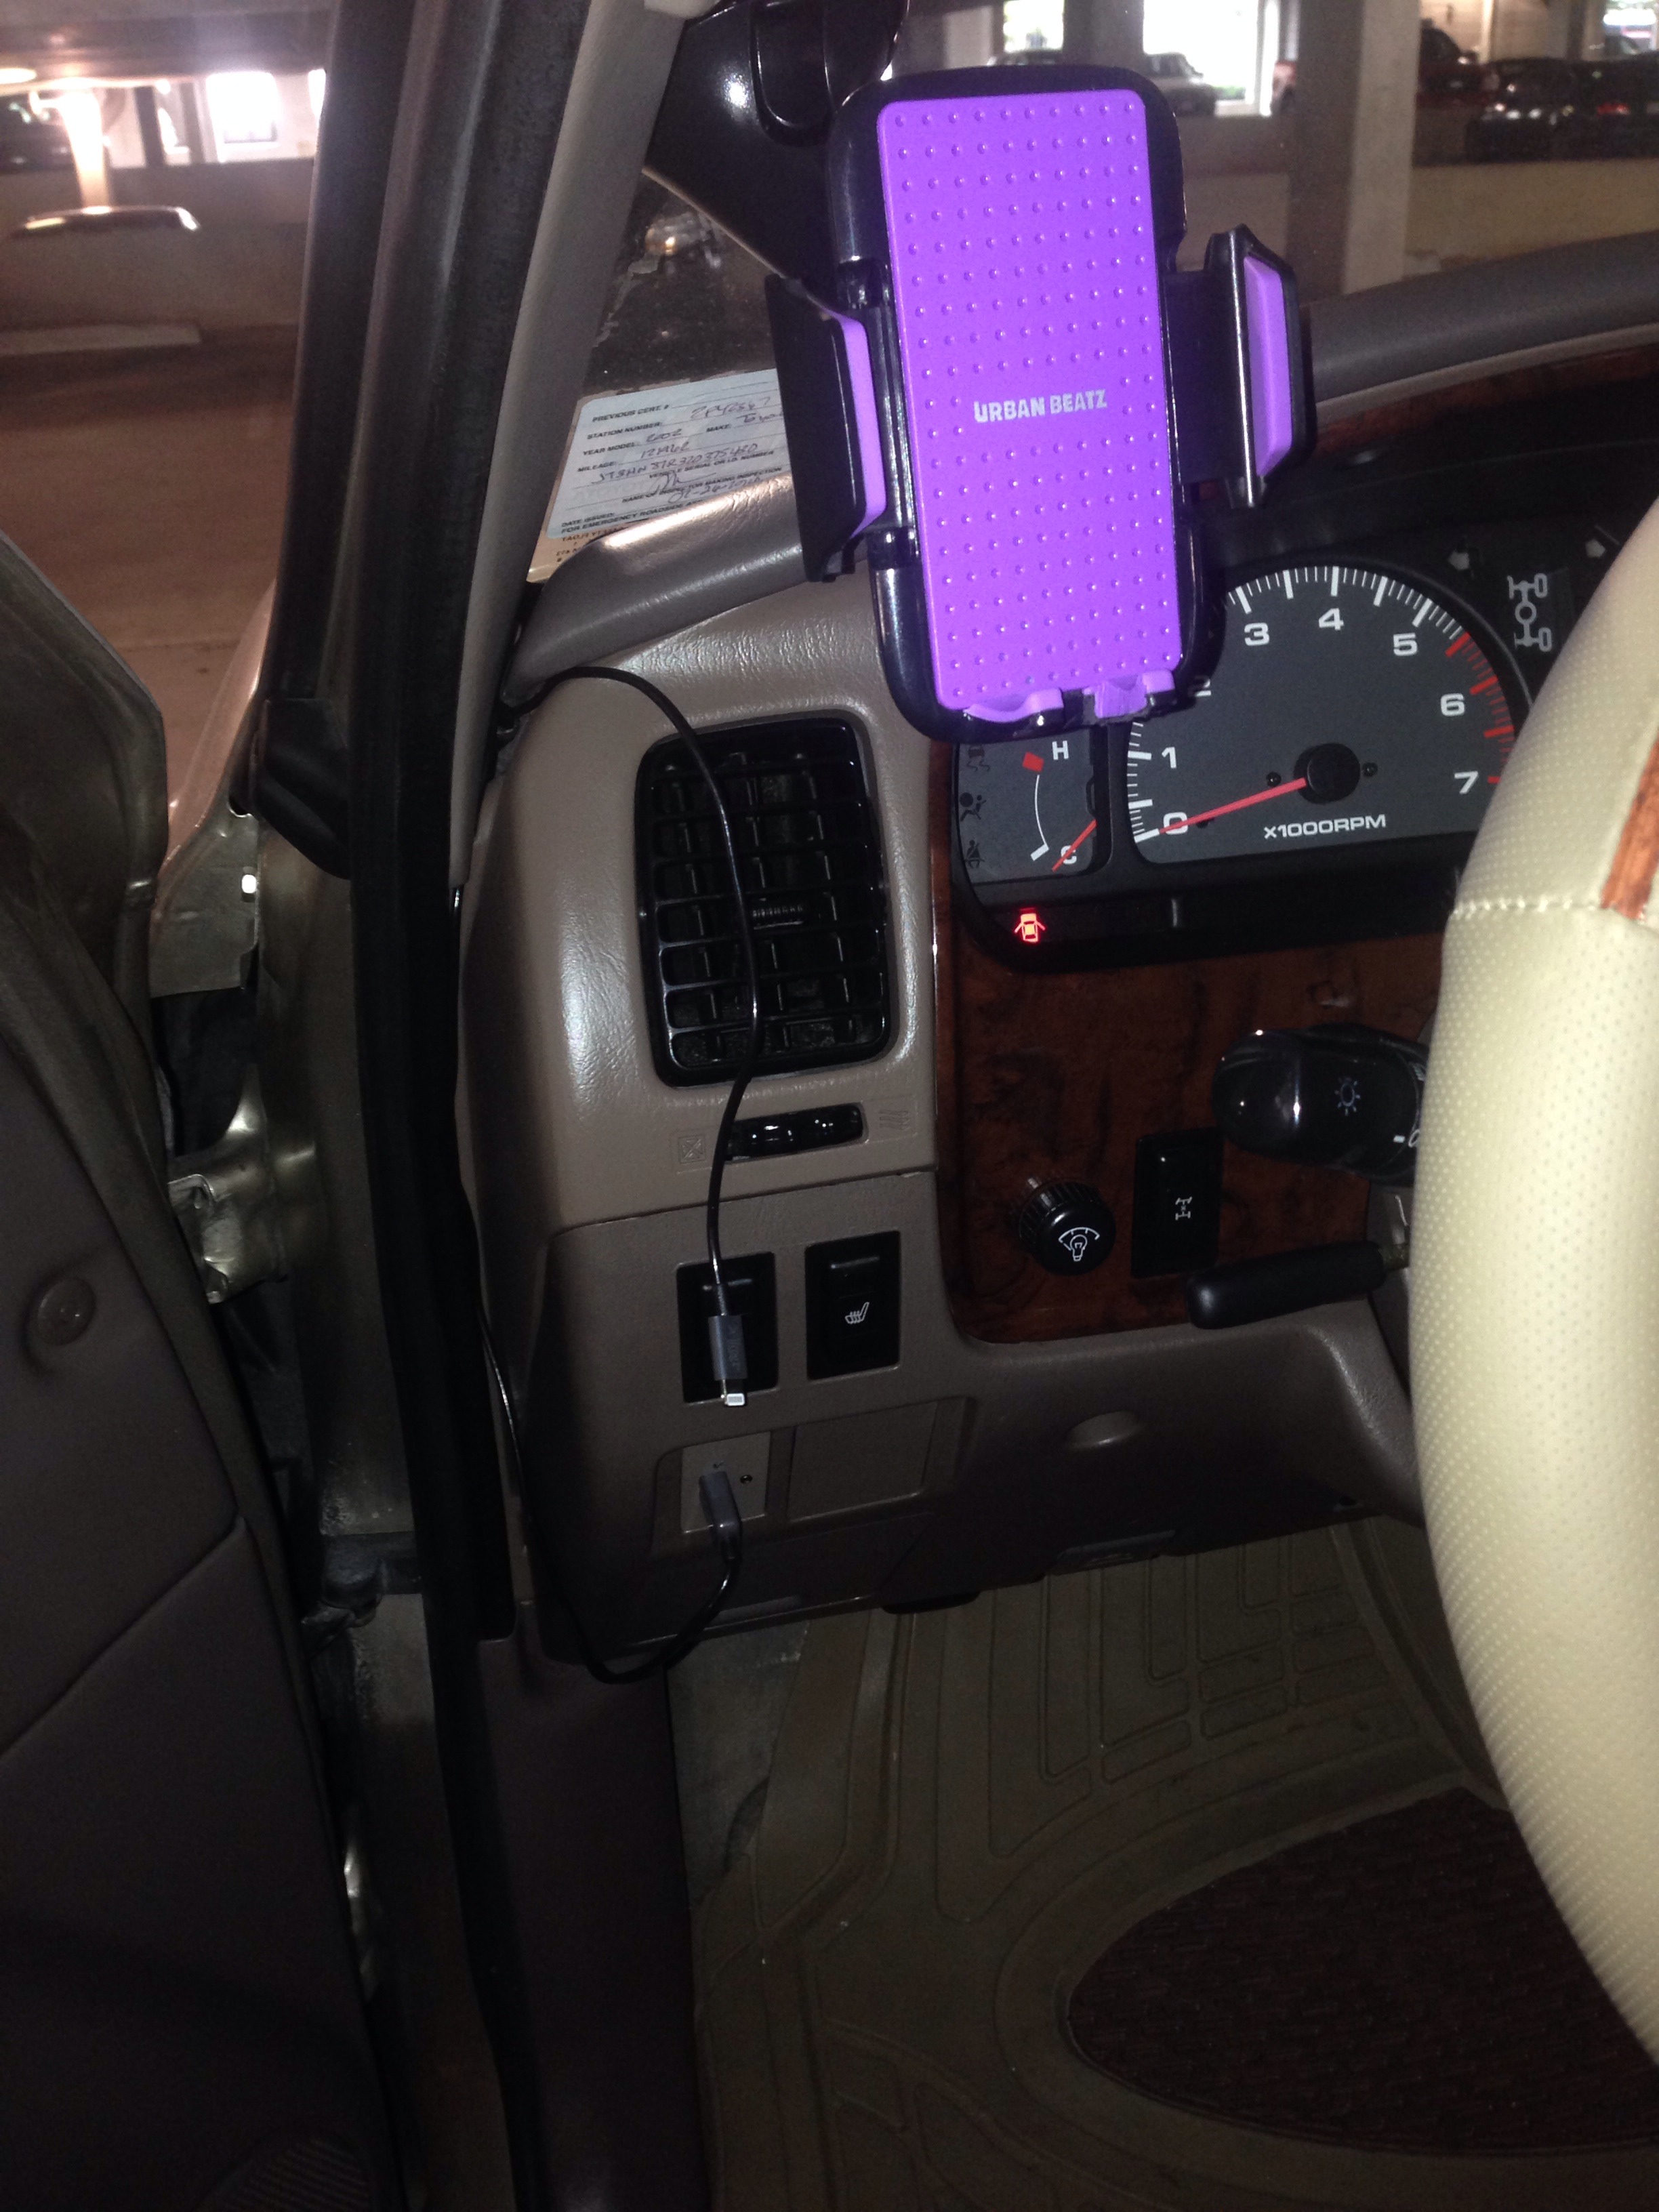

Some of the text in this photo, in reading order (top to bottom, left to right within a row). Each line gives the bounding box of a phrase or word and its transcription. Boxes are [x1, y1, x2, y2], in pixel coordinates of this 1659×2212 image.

[592, 409, 636, 422] PREVIOUS
[974, 389, 1107, 423] URBAN BEATZ
[587, 429, 623, 439] STATION
[583, 447, 605, 455] YEAR
[741, 450, 775, 461] NUMBER
[561, 519, 581, 527] DATE
[582, 513, 638, 529] EMERGENCY
[1318, 608, 1345, 631] 4
[1244, 622, 1270, 647] 3
[1393, 632, 1418, 657] 5
[1441, 693, 1465, 717] 6
[1052, 740, 1069, 760] H
[1161, 746, 1176, 769] 1
[1454, 771, 1479, 794] 7
[1163, 811, 1189, 835] 0
